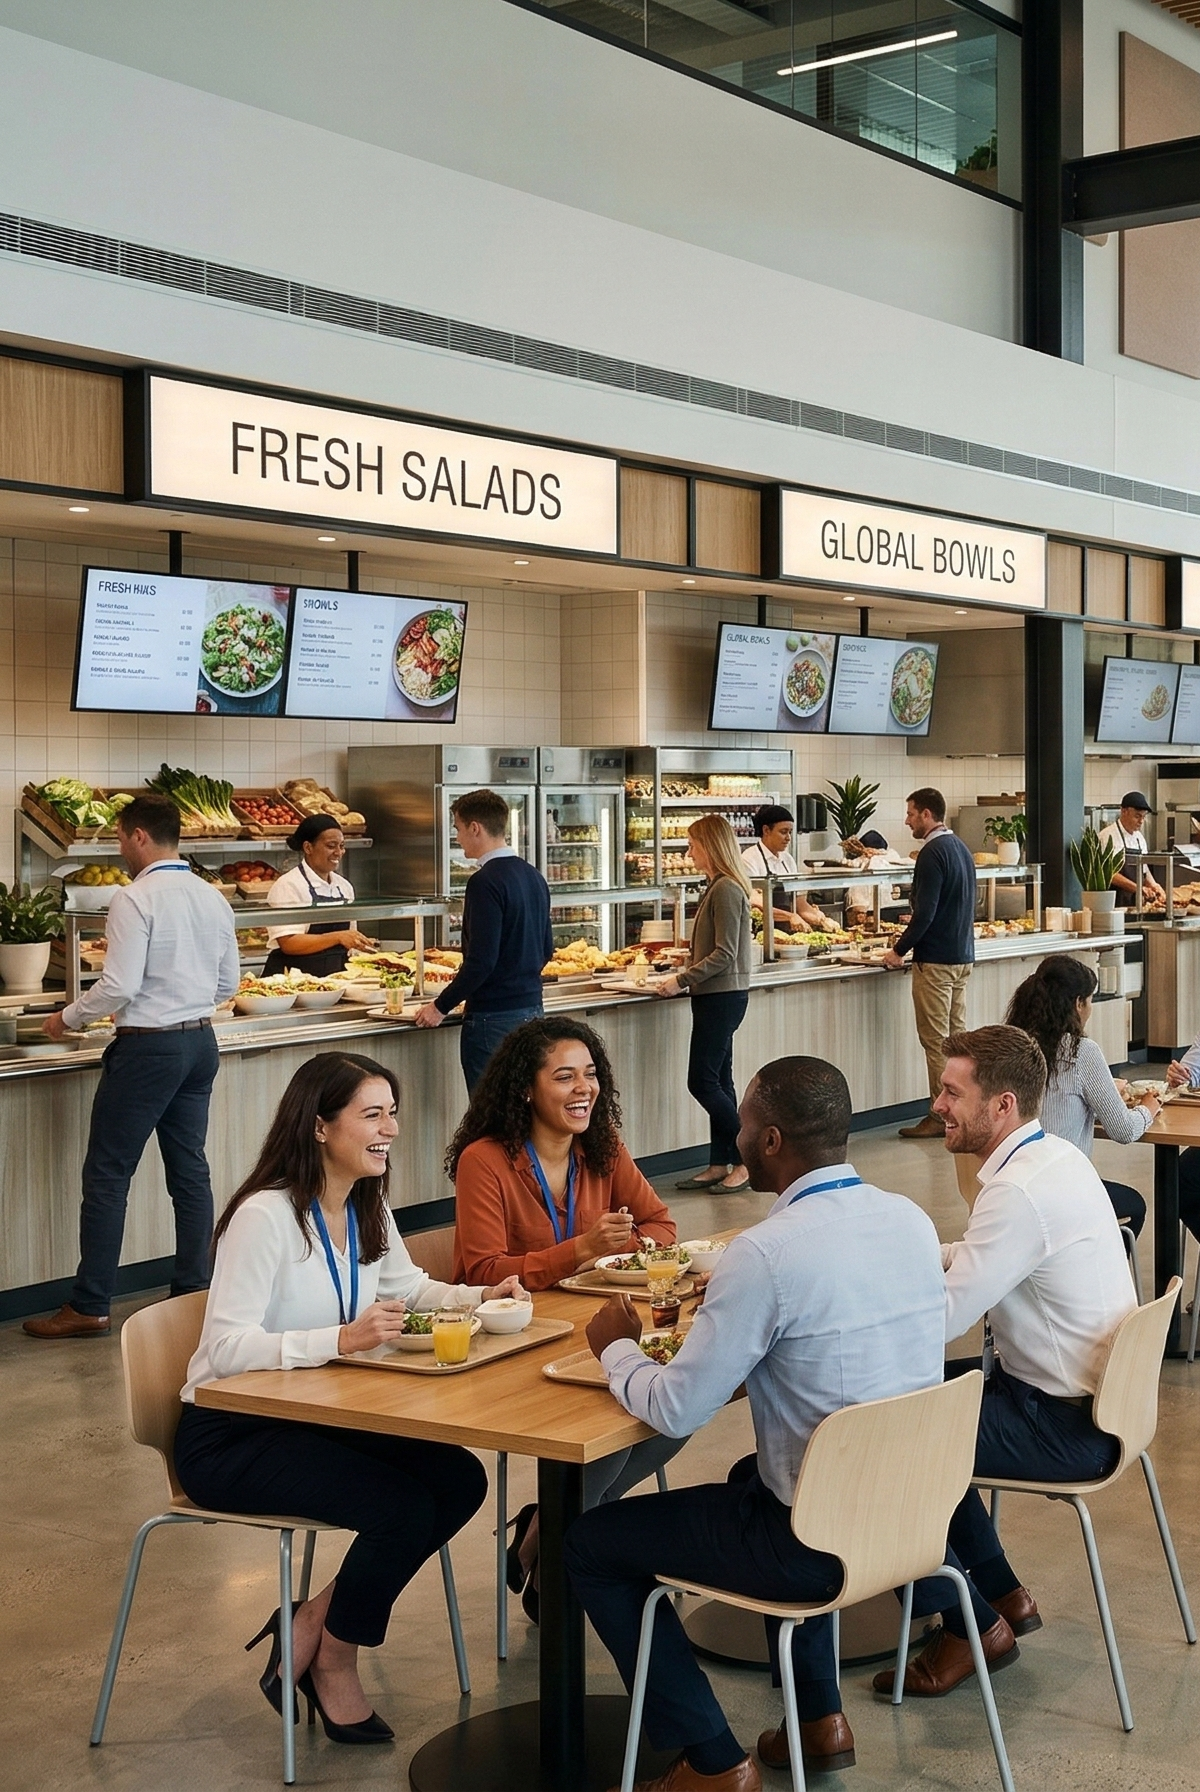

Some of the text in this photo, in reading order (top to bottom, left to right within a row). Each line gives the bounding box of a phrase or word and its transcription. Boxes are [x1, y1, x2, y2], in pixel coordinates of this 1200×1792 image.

[232, 421, 563, 521] FRESH SALADS
[821, 519, 1016, 584] GLOBAL BOWLS
[98, 580, 132, 594] FRESH
